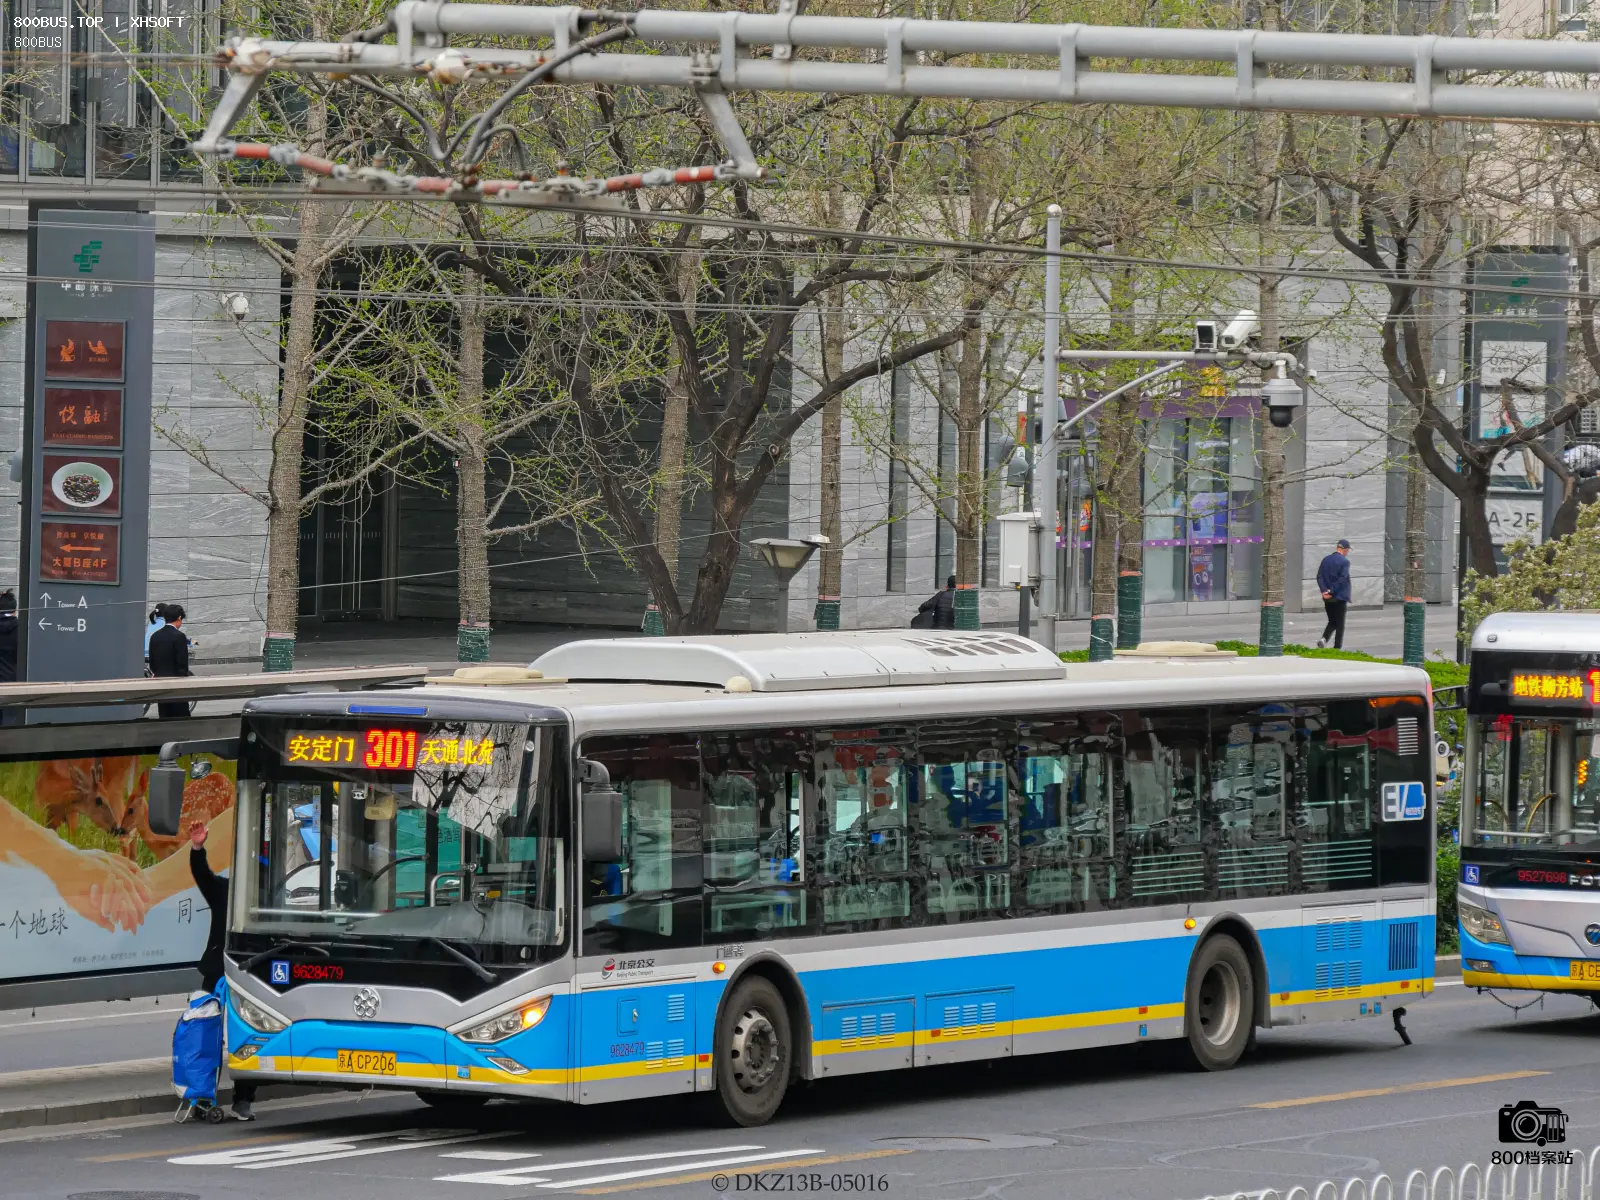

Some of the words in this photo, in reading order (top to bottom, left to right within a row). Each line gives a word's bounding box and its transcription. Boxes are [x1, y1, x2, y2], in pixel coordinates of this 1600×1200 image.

[77, 595, 88, 609] A
[56, 624, 76, 632] Tower
[77, 618, 87, 632] B
[288, 734, 355, 762] 安定门
[365, 729, 417, 769] 301
[421, 738, 495, 766] 天通北苑
[292, 964, 344, 980] 9628479
[618, 958, 656, 971] 北京公交
[610, 1041, 645, 1058] 9628479
